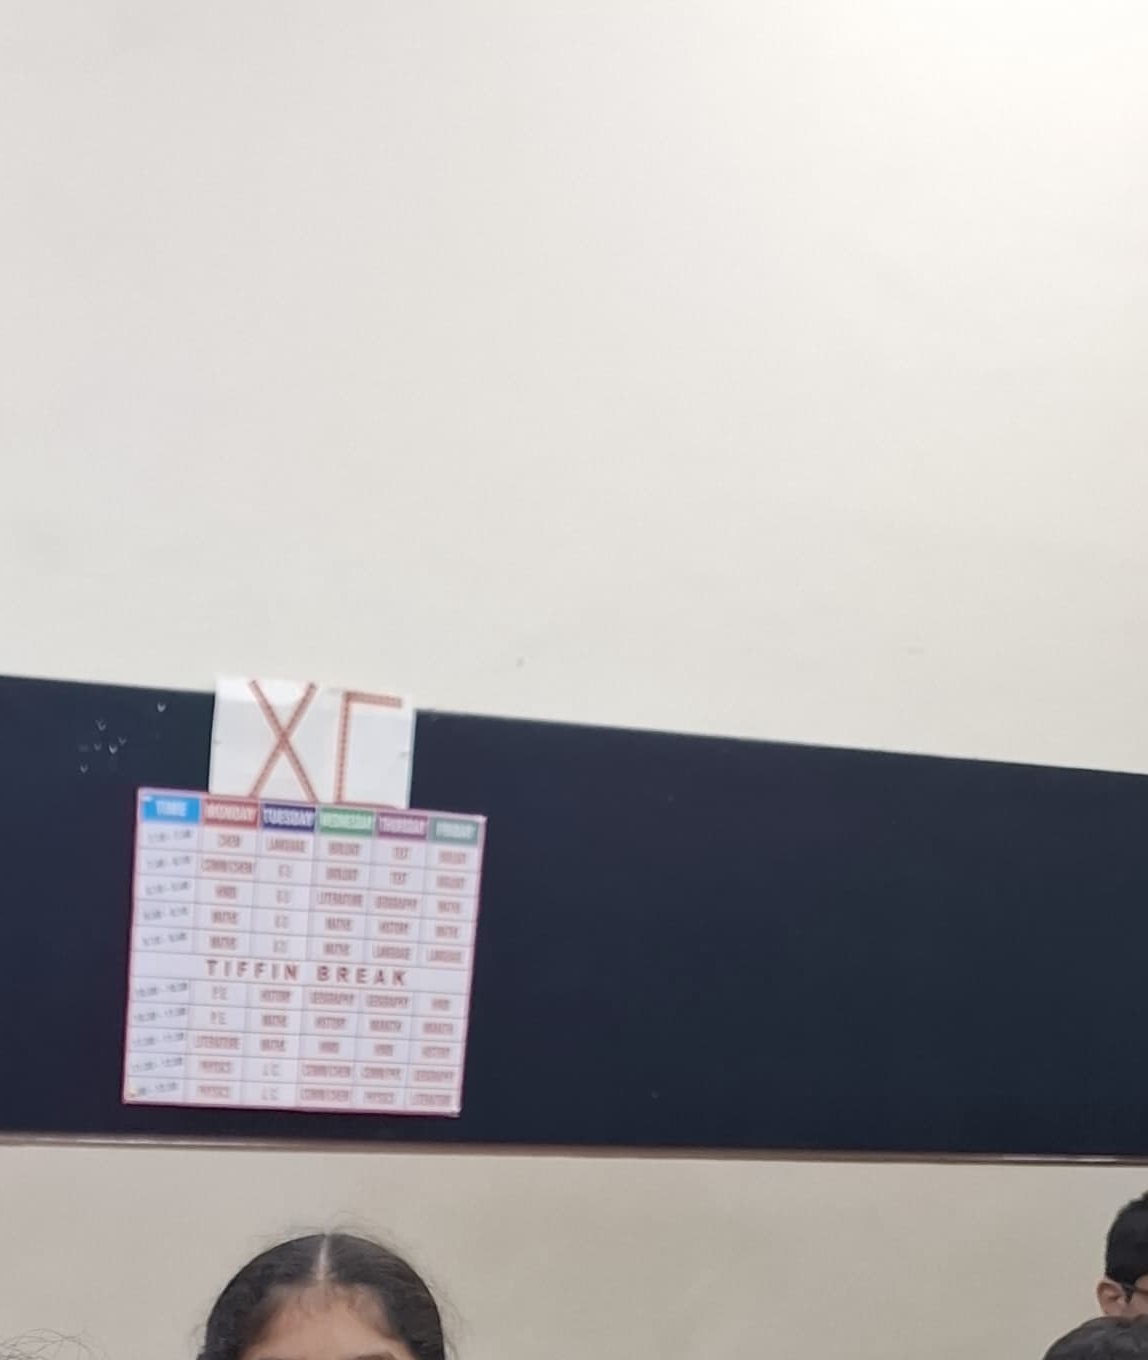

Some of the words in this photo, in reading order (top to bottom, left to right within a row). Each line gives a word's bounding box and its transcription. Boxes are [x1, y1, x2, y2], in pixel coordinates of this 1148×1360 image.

[263, 808, 315, 826] TUESDAY
[206, 959, 299, 981] TIFFIN
[316, 965, 407, 986] BREAK
